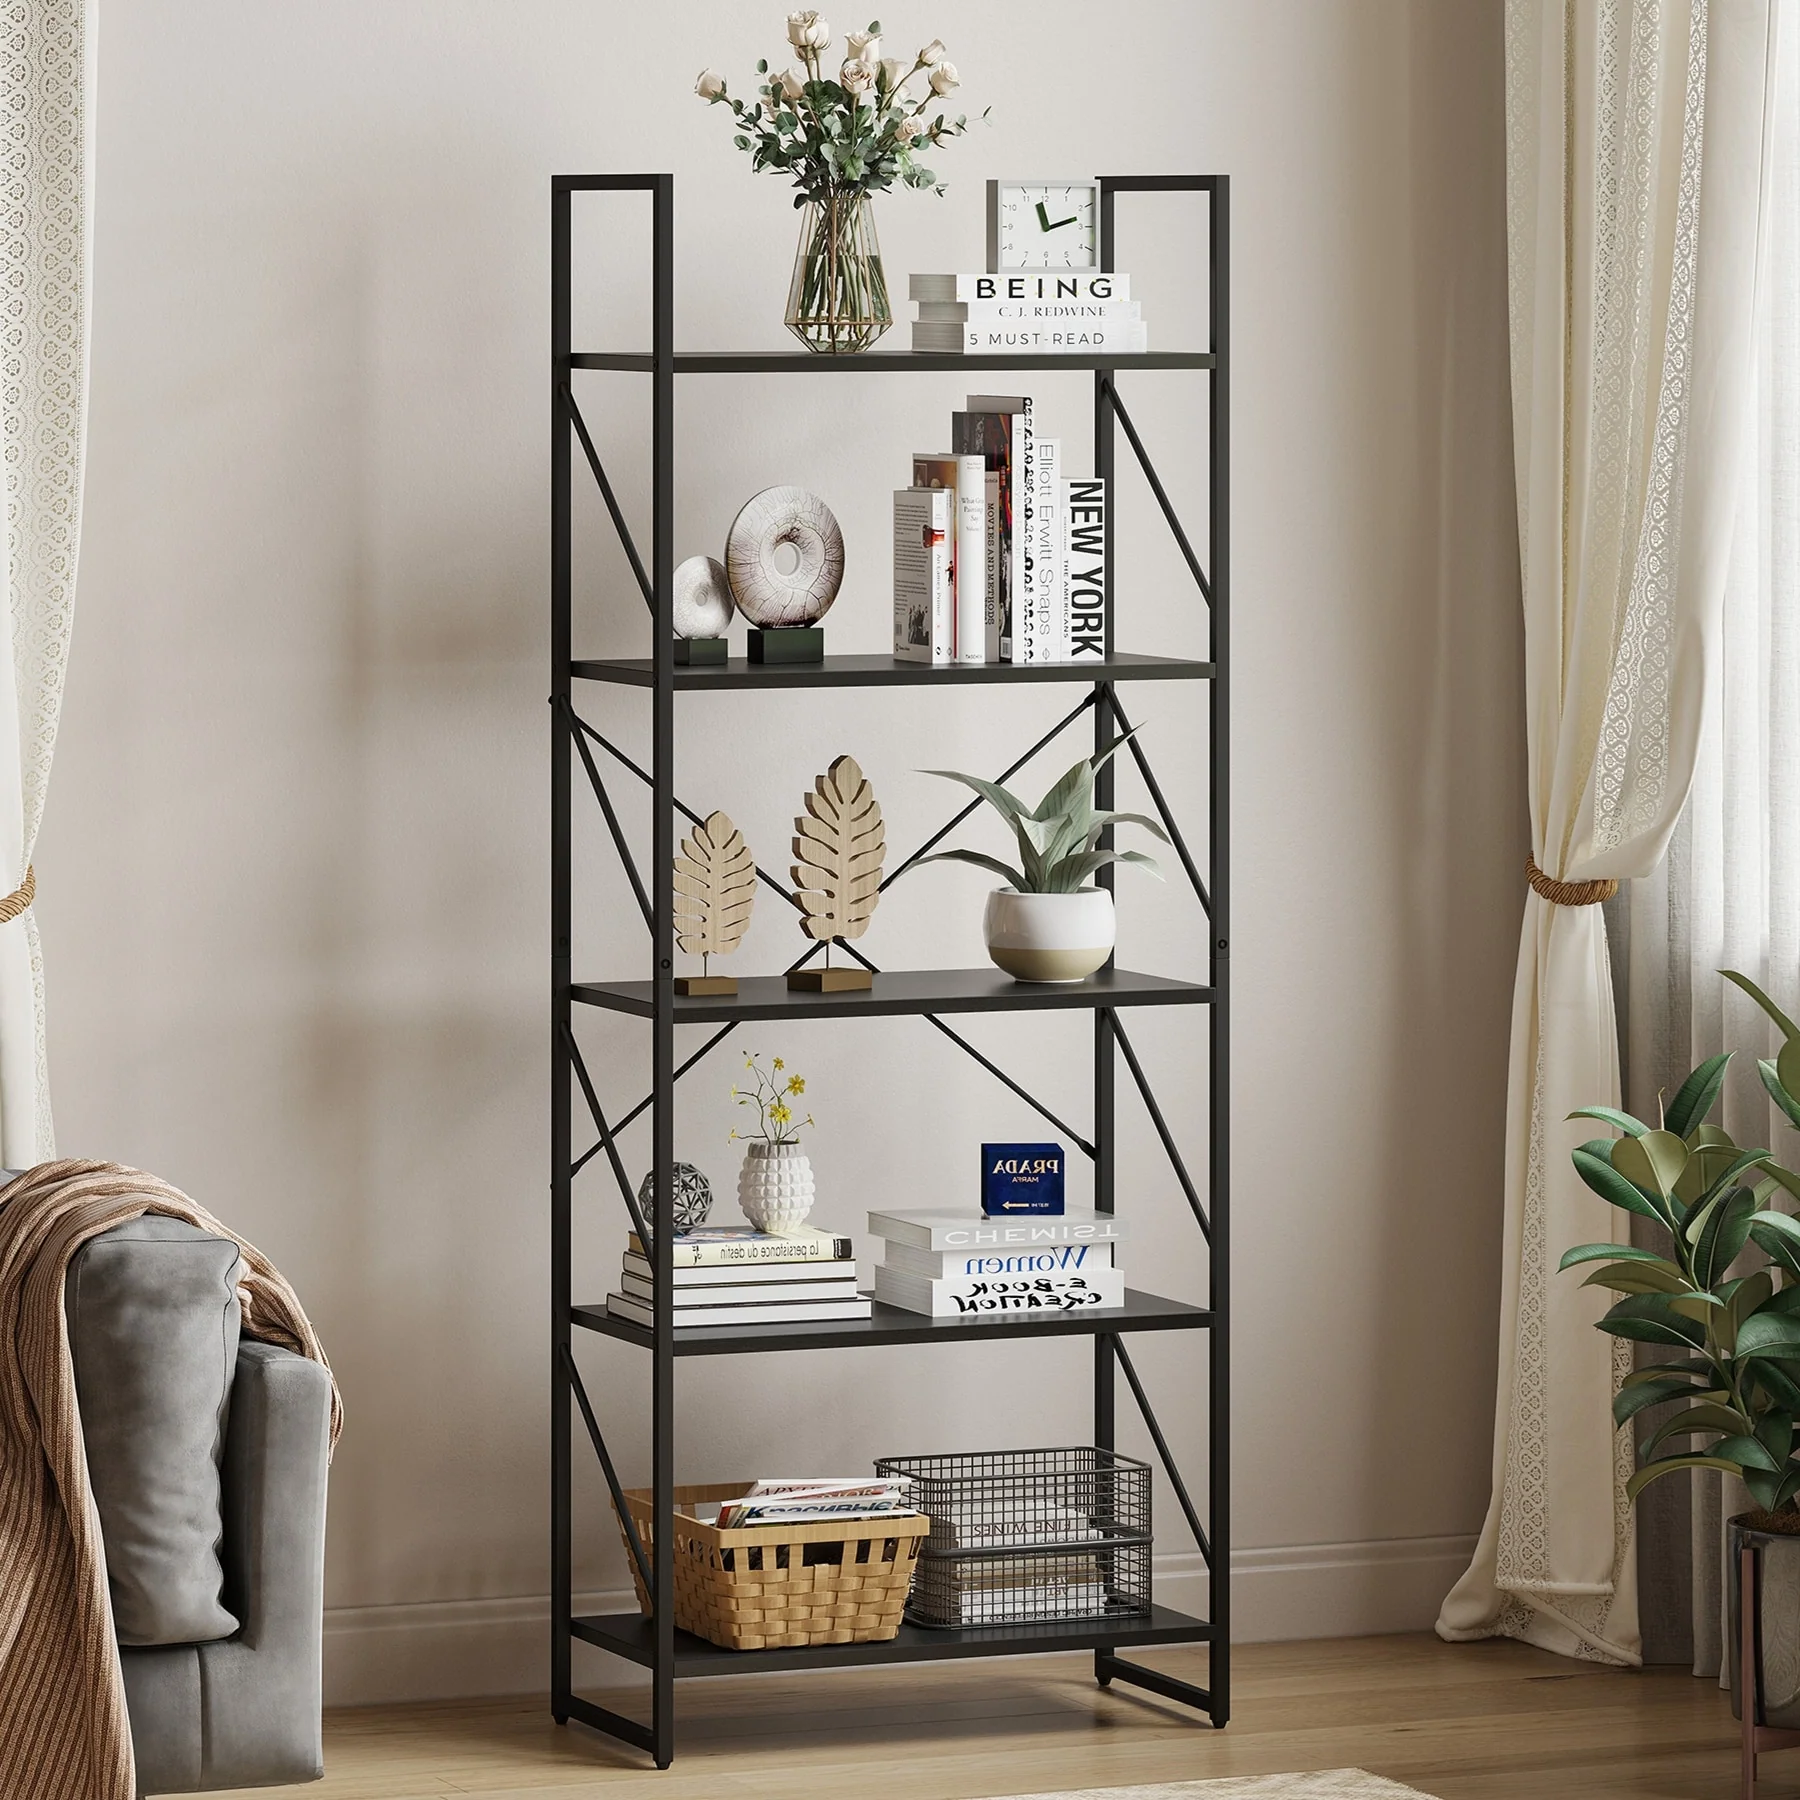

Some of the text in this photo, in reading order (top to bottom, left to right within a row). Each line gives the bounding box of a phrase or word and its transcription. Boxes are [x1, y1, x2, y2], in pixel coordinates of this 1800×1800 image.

[1041, 195, 1050, 203] 12
[1008, 204, 1017, 212] 10
[1078, 204, 1083, 212] 2
[1008, 243, 1014, 251] 8
[976, 278, 1113, 299] BEING
[998, 306, 1106, 317] C. J. REDWINE
[970, 333, 1105, 346] 5 MUST-READ
[1037, 444, 1054, 636] Elliott Erwitt Snaps
[987, 502, 995, 625] MOVIES AND METHODS
[1069, 482, 1103, 657] NEW YORK
